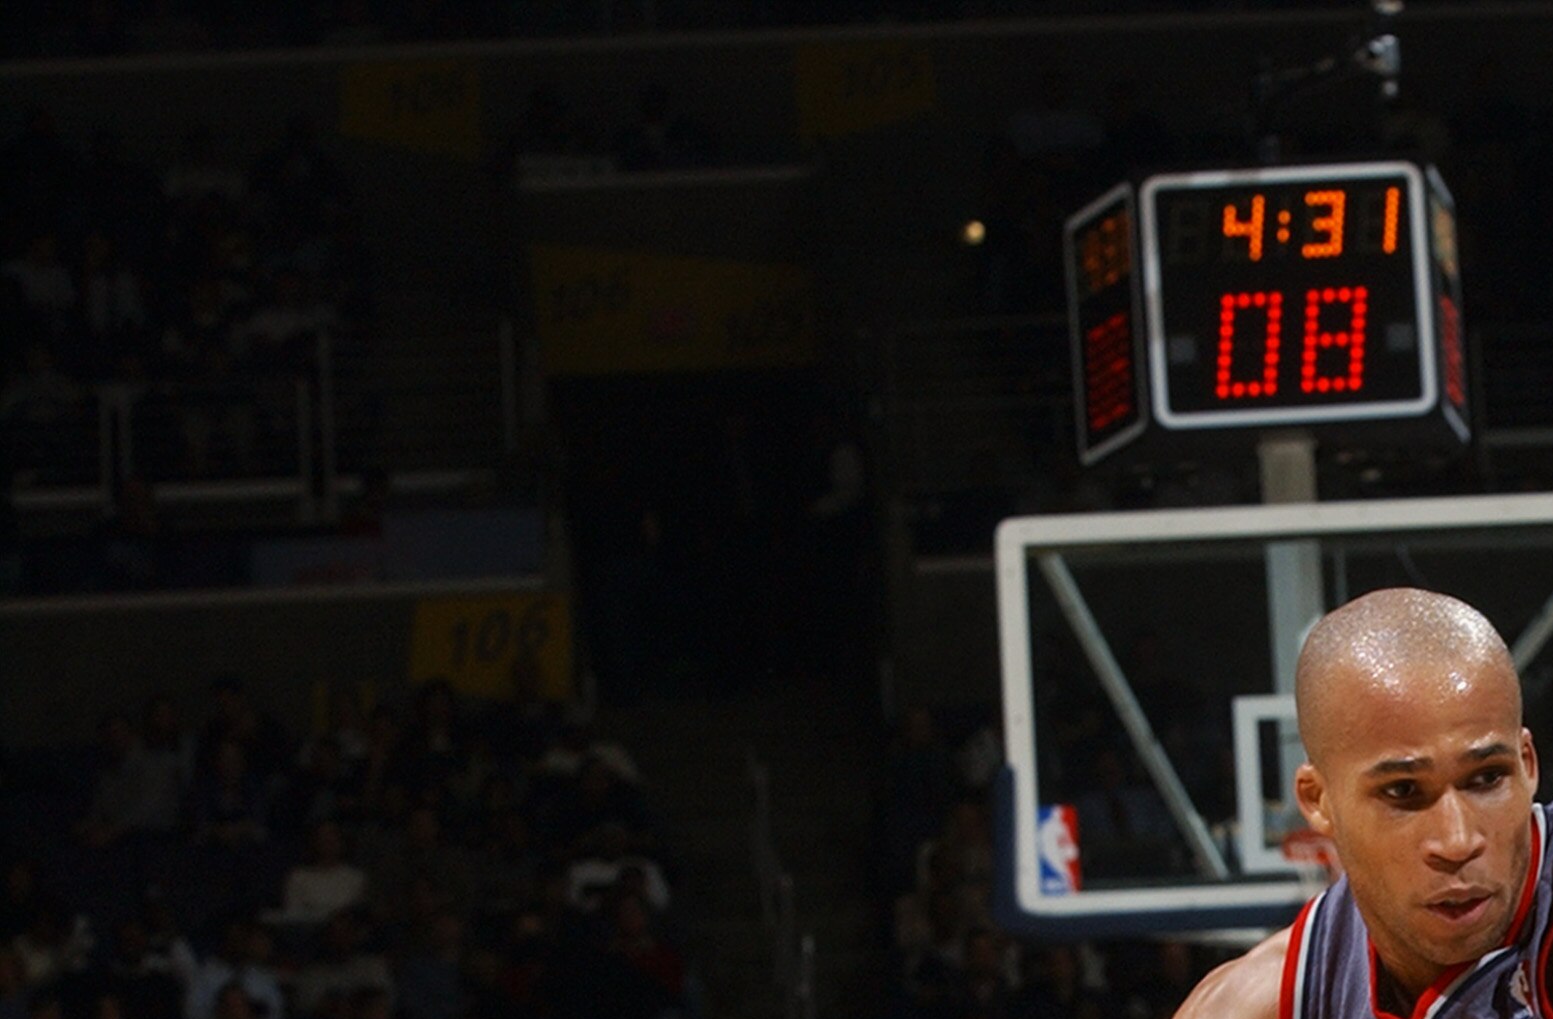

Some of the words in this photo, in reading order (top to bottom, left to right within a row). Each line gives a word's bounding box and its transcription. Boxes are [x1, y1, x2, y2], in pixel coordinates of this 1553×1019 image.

[1222, 187, 1400, 262] 4:31
[1215, 286, 1368, 399] 08
[448, 605, 550, 668] 106
